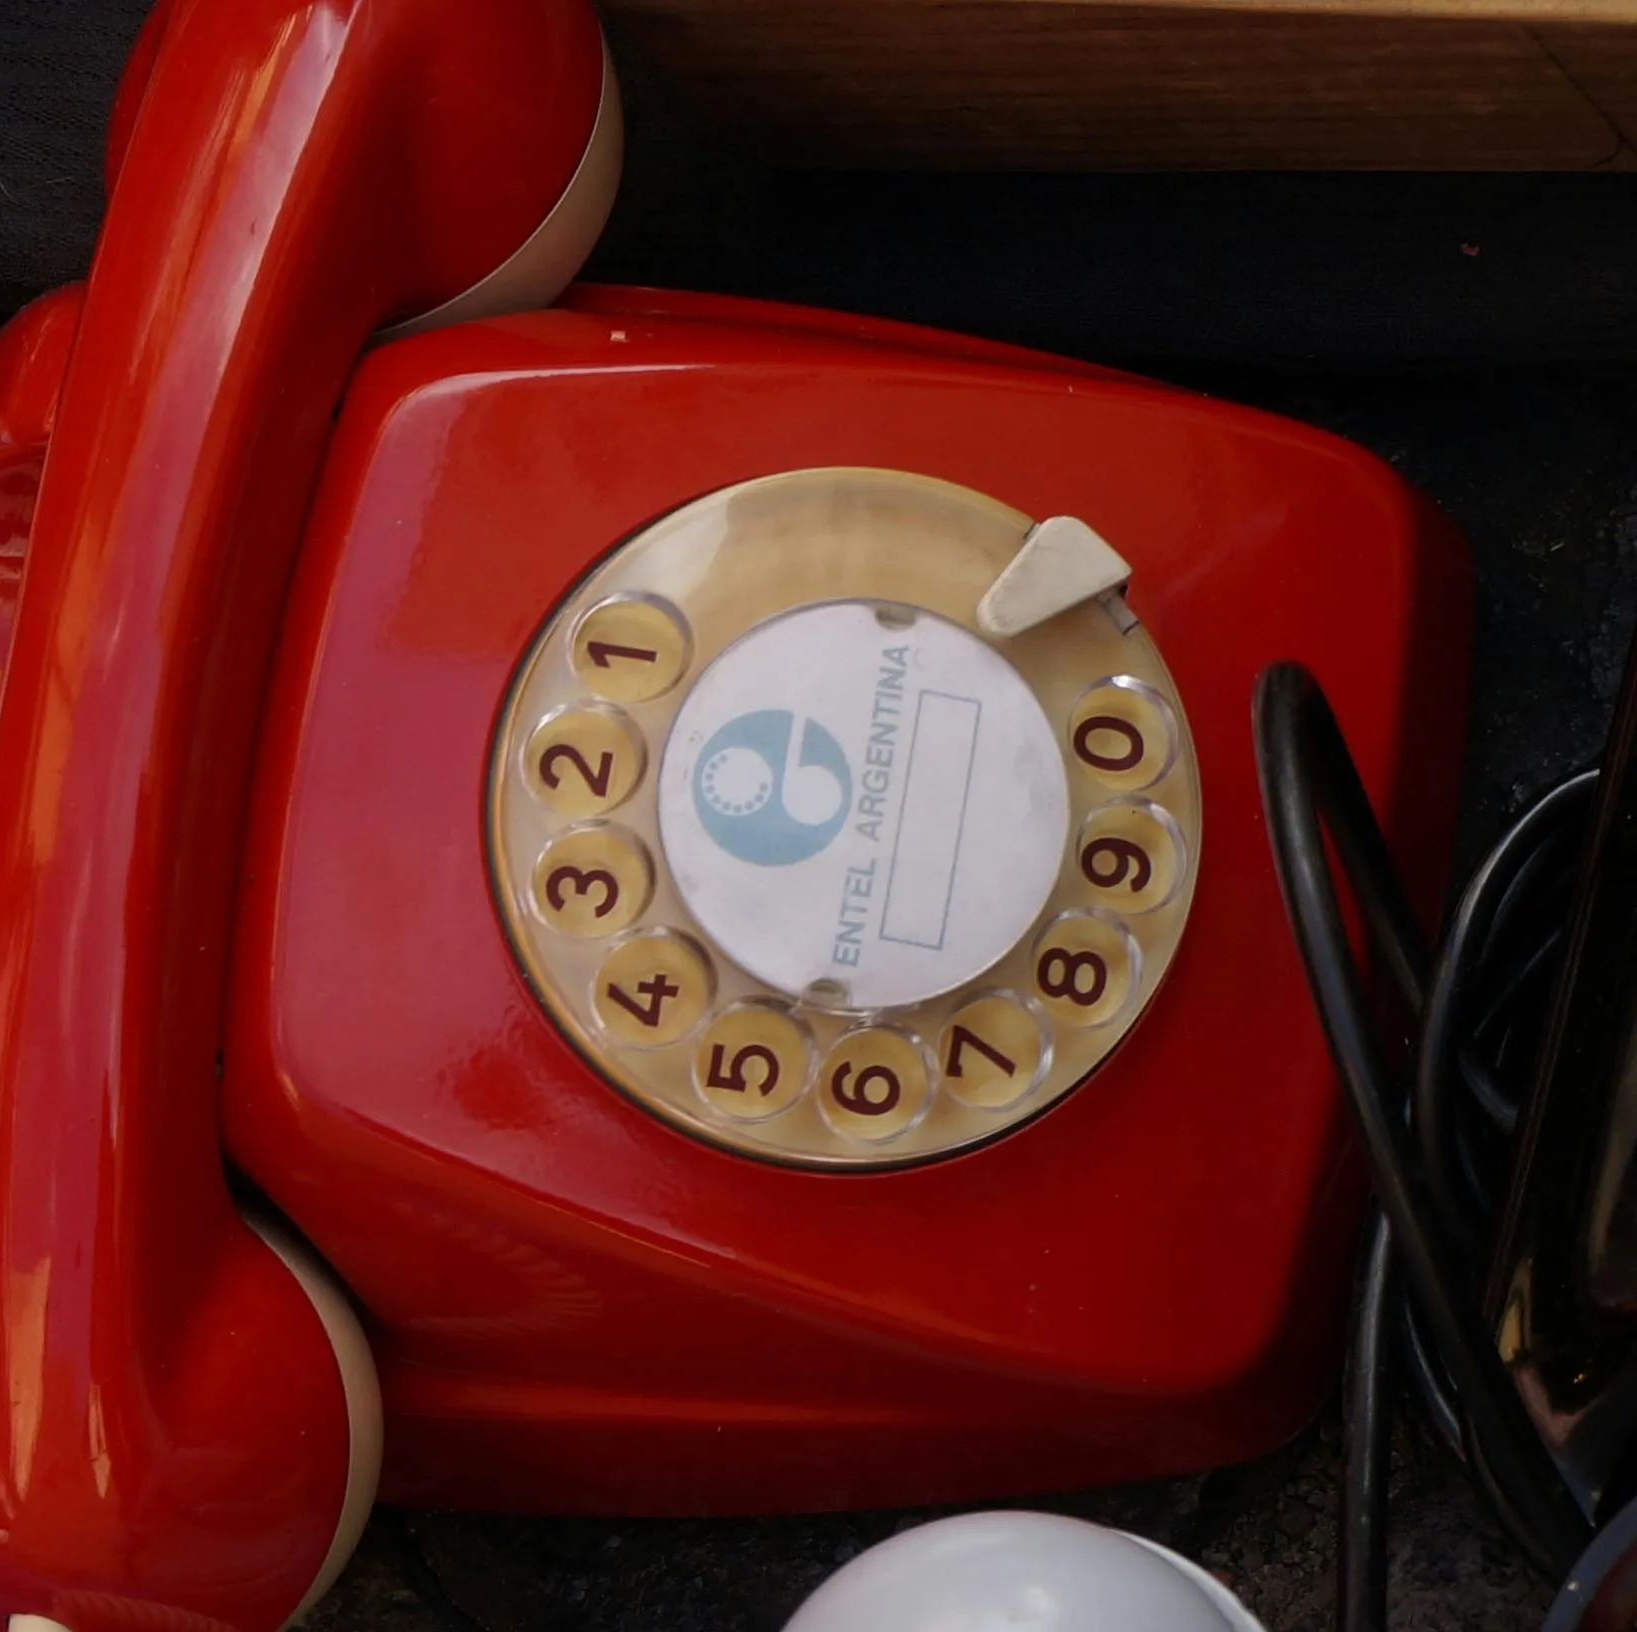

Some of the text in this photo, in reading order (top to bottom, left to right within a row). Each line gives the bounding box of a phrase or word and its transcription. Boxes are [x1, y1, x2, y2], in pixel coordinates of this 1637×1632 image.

[539, 639, 1152, 1116] 1 2 3 4 5 6 7 8 9 0
[831, 644, 911, 968] ENTEL ARGENTINA
